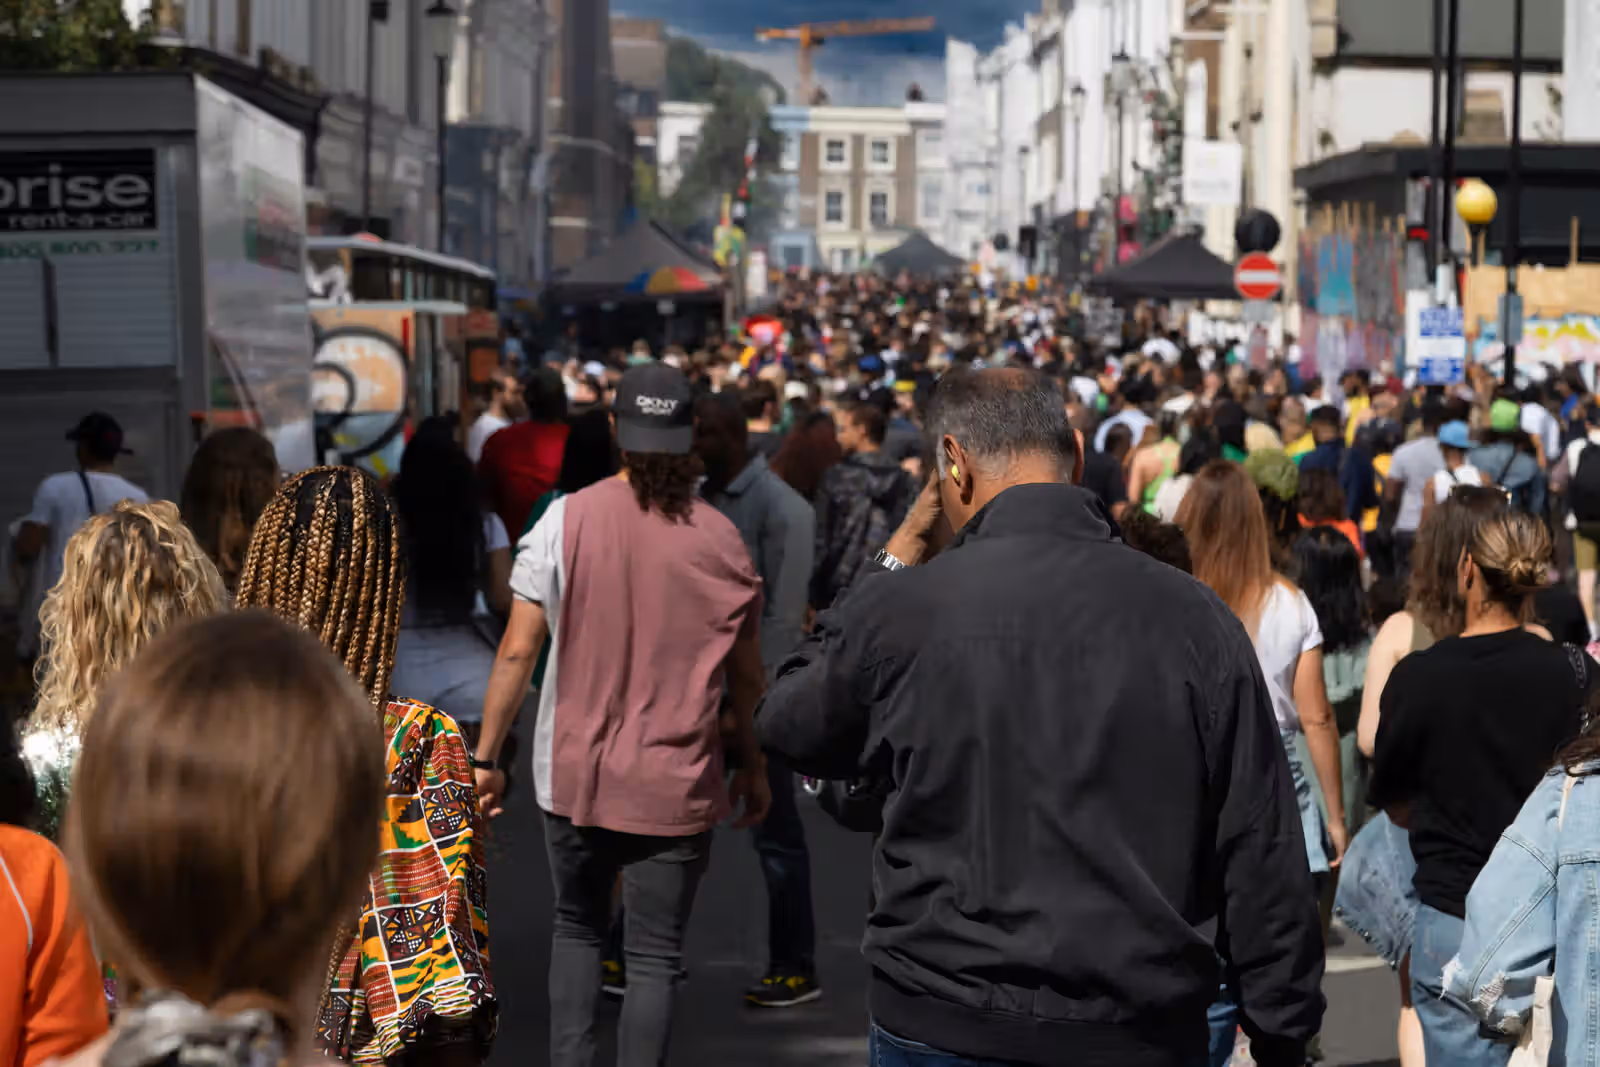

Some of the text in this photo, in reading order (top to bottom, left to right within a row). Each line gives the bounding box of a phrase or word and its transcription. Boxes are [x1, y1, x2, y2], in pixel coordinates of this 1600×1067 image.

[8, 210, 151, 228] rent-a-car
[635, 395, 679, 410] DKNY
[641, 407, 673, 416] SPORT
